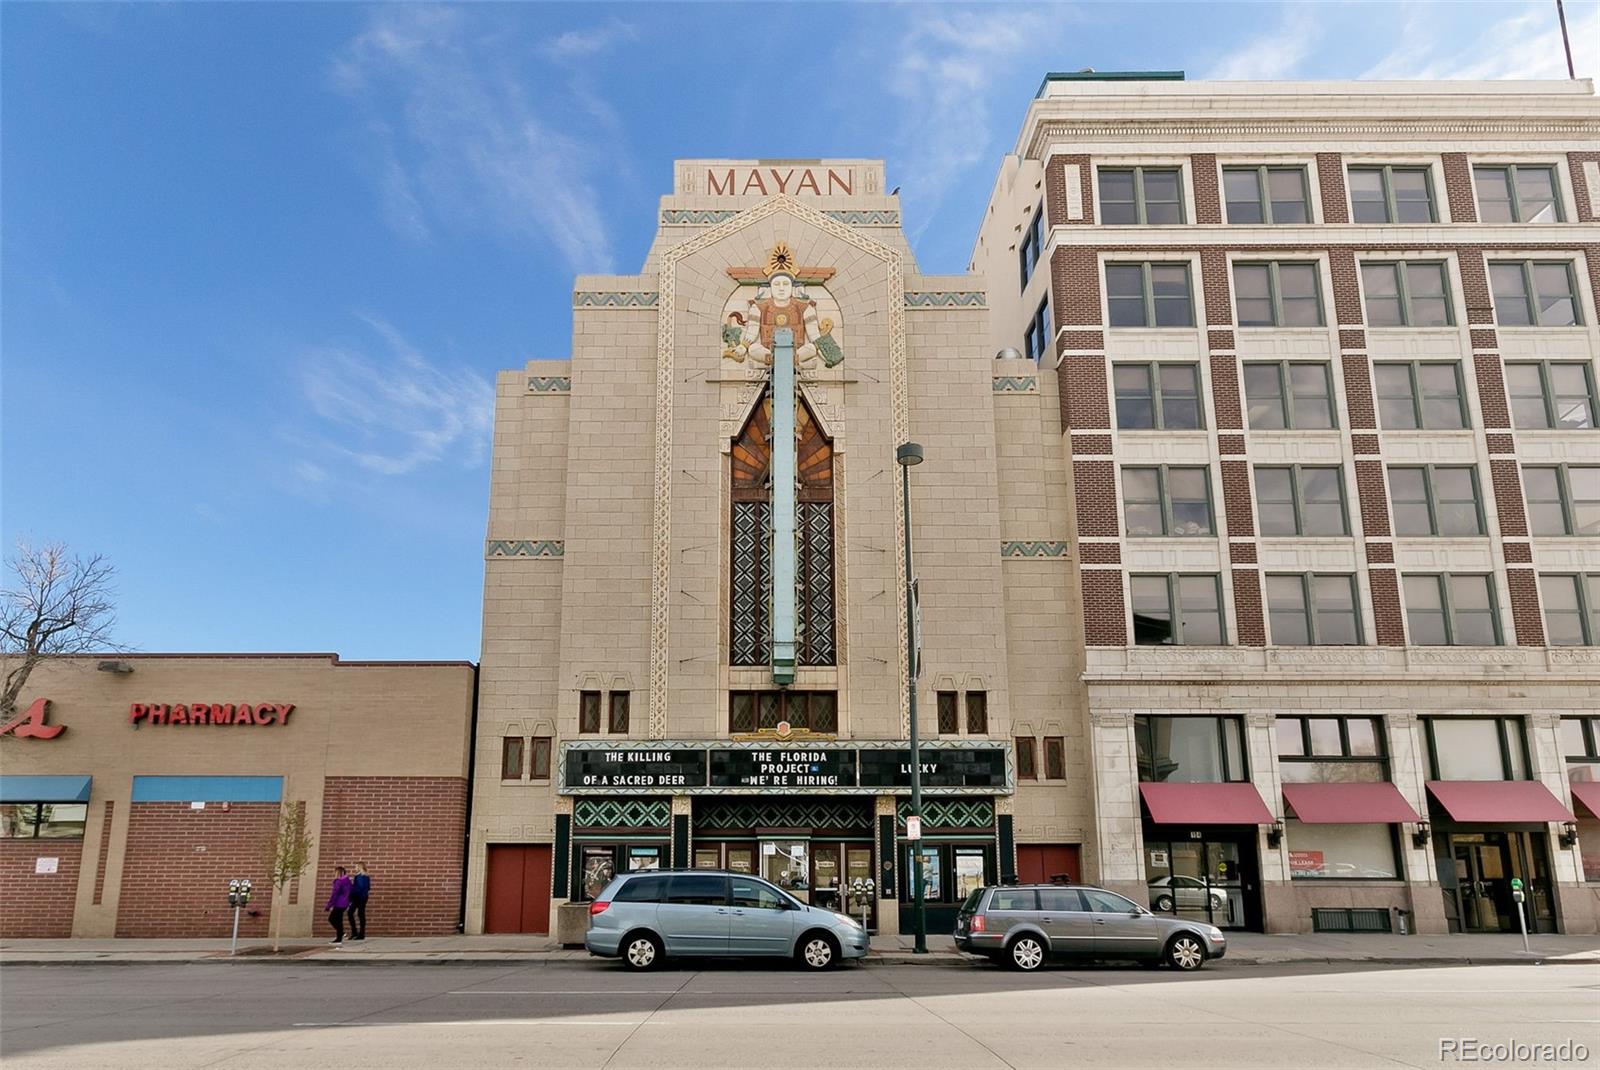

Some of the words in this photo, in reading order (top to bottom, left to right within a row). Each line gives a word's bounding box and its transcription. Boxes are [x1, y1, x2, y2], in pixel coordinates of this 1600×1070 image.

[707, 168, 852, 196] MAYAN
[128, 703, 296, 726] PHARMACY
[605, 752, 624, 762] THE
[627, 752, 672, 762] KILLING
[751, 752, 772, 762] THE
[780, 752, 827, 762] FLORIDA
[761, 764, 810, 774] PROJECT
[583, 775, 597, 785] OF
[601, 775, 609, 785] A
[613, 775, 654, 785] SACRED
[659, 774, 685, 785] DEER
[796, 775, 838, 785] HIRING!
